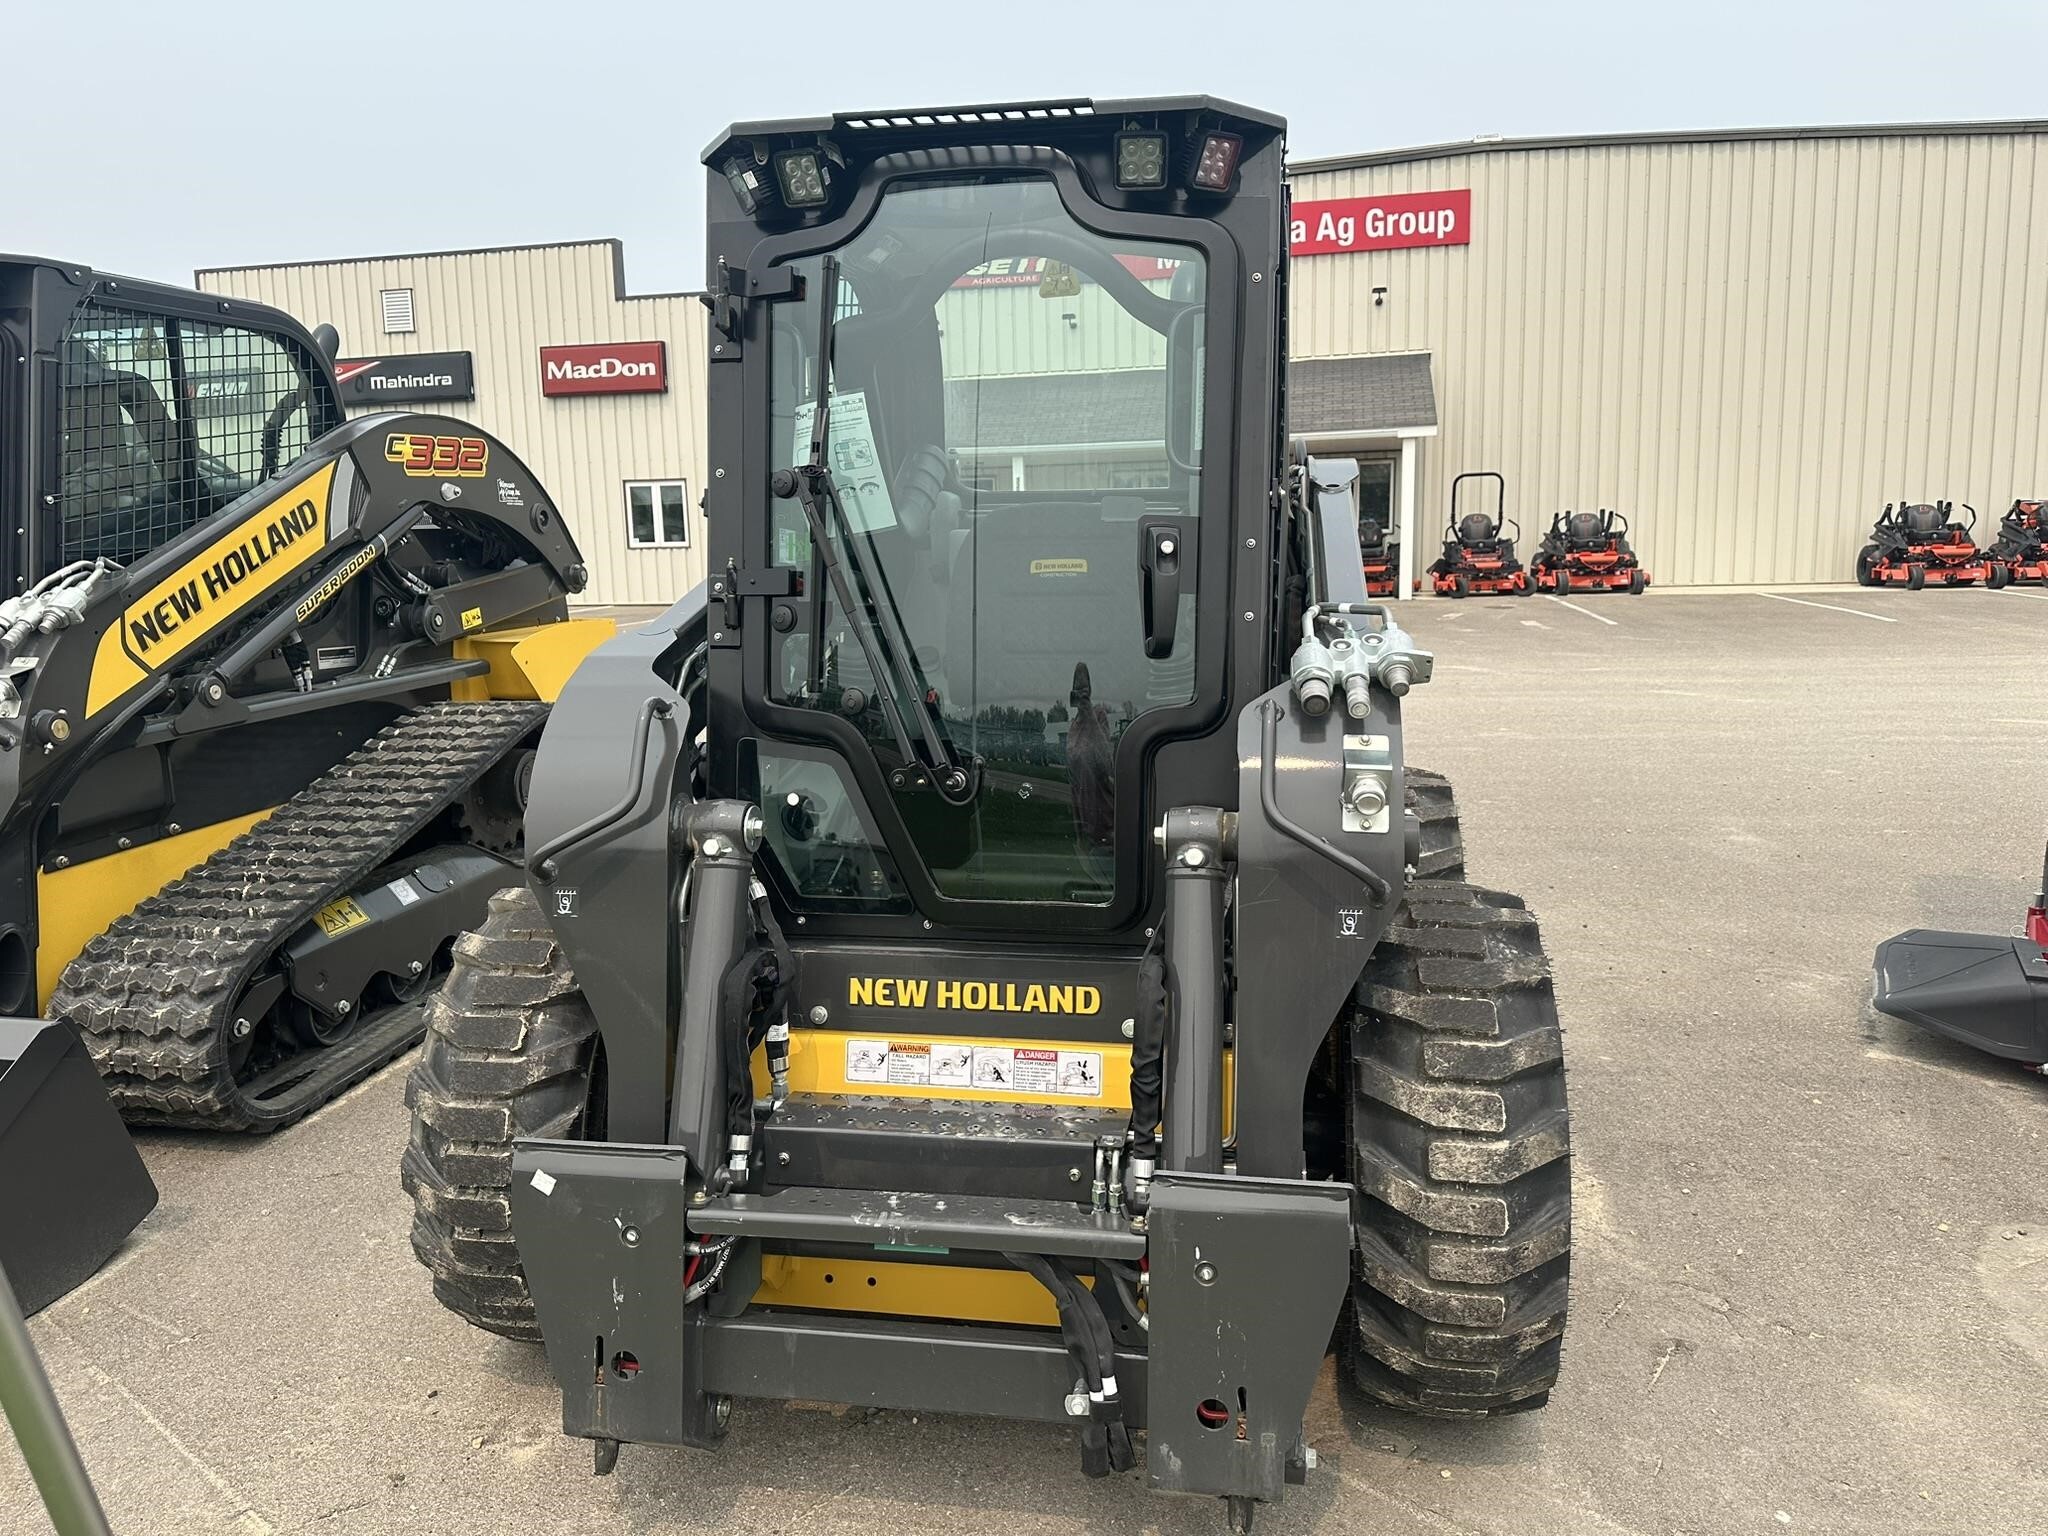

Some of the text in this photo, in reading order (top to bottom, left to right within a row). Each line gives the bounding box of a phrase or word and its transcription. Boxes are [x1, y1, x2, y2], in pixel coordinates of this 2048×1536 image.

[1315, 212, 1355, 246] Ag
[1365, 208, 1455, 239] Group
[972, 276, 1039, 285] AGRICULTURE
[547, 358, 656, 380] MacDon
[370, 373, 452, 389] Mahindra
[129, 499, 318, 653] NEW HOLLAND
[296, 544, 376, 622] SUPER BOOM
[850, 978, 1101, 1015] NEW HOLLAND
[896, 1044, 929, 1053] WARNING
[1025, 1051, 1056, 1060] DANGER
